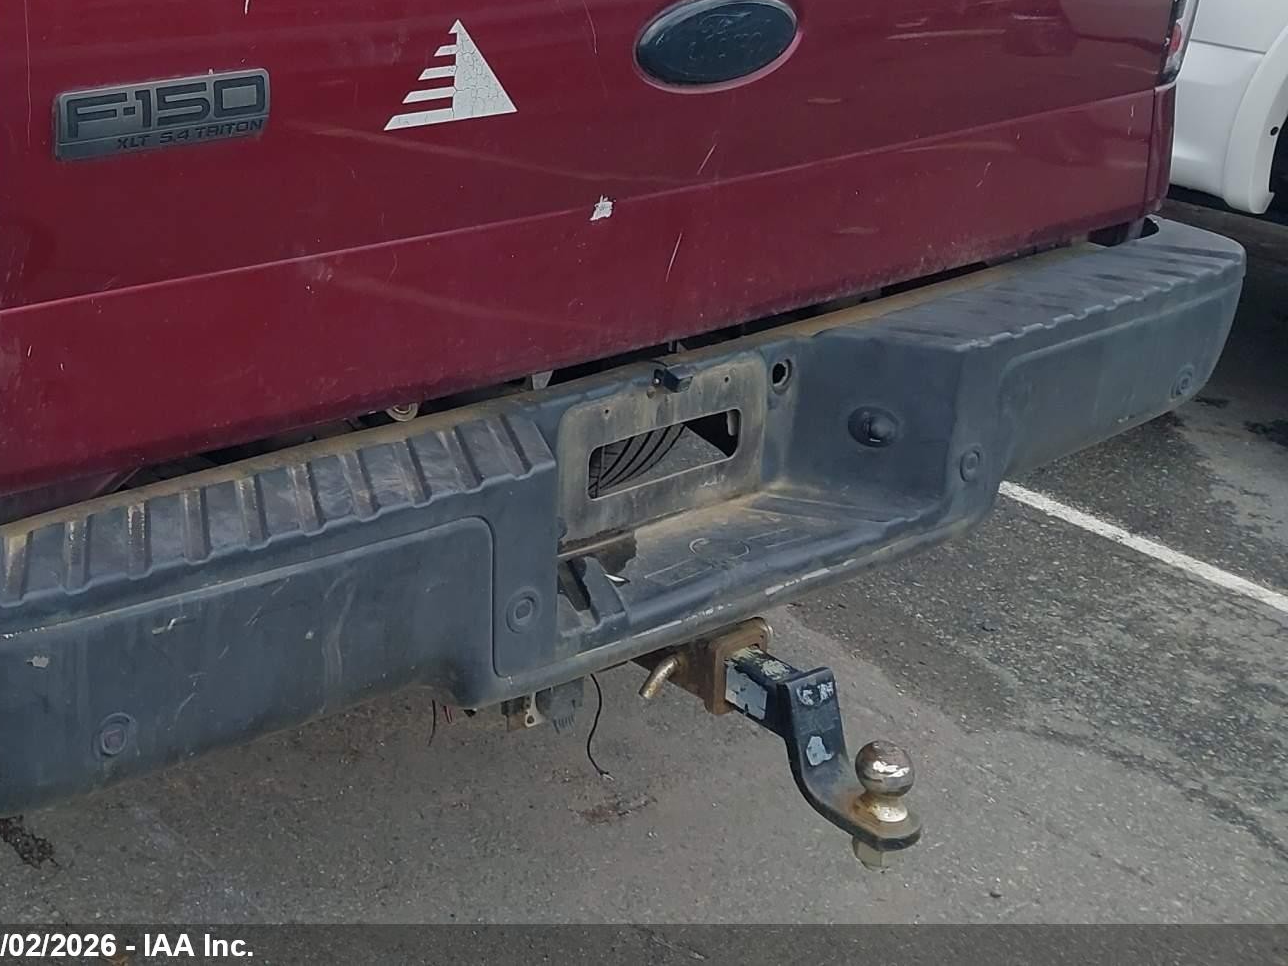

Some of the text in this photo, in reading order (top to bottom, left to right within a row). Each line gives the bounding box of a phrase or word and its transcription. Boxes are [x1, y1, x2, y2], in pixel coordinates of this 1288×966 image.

[66, 74, 266, 138] F-150
[116, 134, 152, 150] XLT
[194, 118, 264, 140] TRITON
